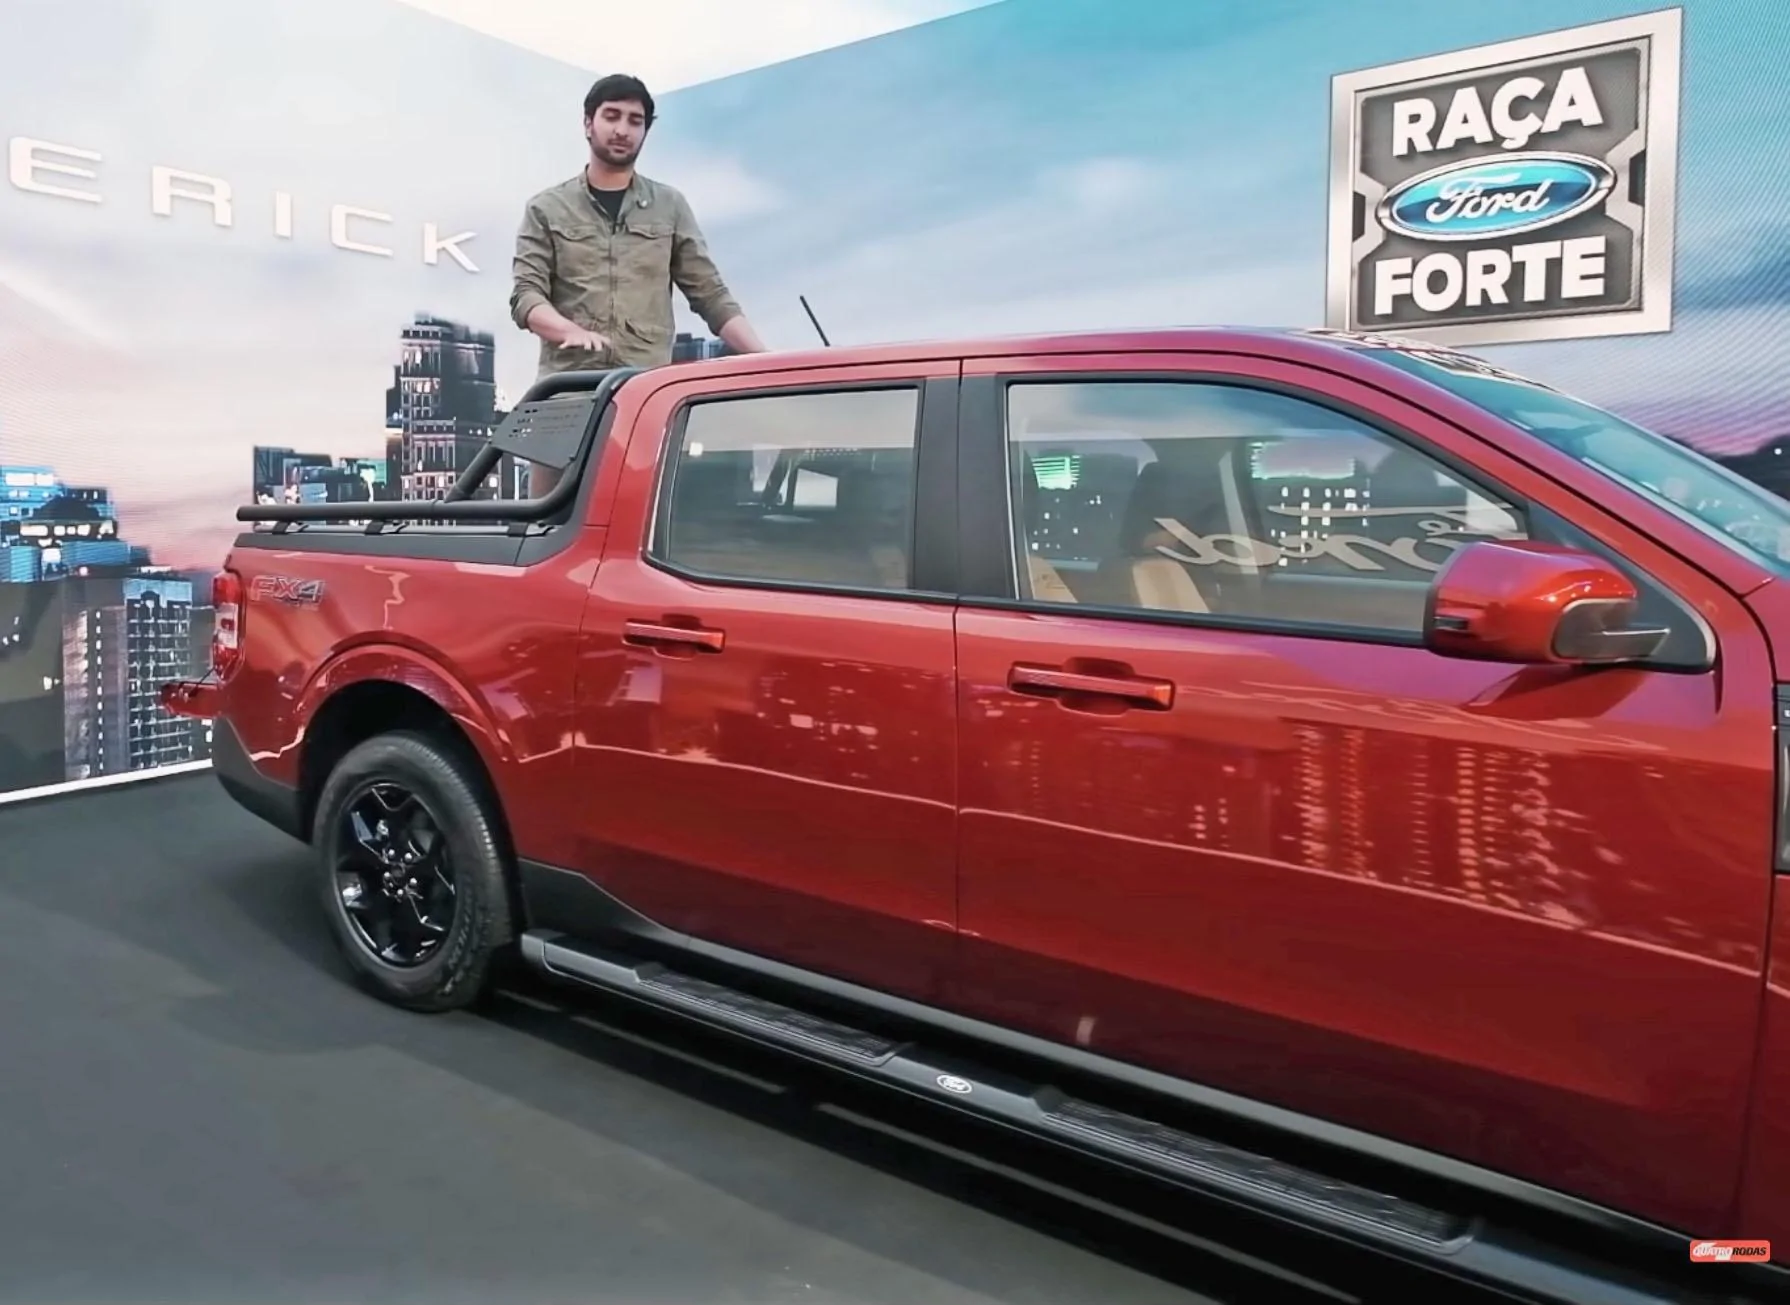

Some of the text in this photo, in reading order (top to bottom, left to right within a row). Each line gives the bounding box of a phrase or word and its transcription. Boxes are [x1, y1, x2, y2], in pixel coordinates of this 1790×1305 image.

[1392, 66, 1603, 156] RAÇA
[9, 136, 481, 273] ERICK
[1425, 171, 1553, 224] Ford
[1374, 235, 1607, 316] FORTE
[250, 575, 325, 604] FX4
